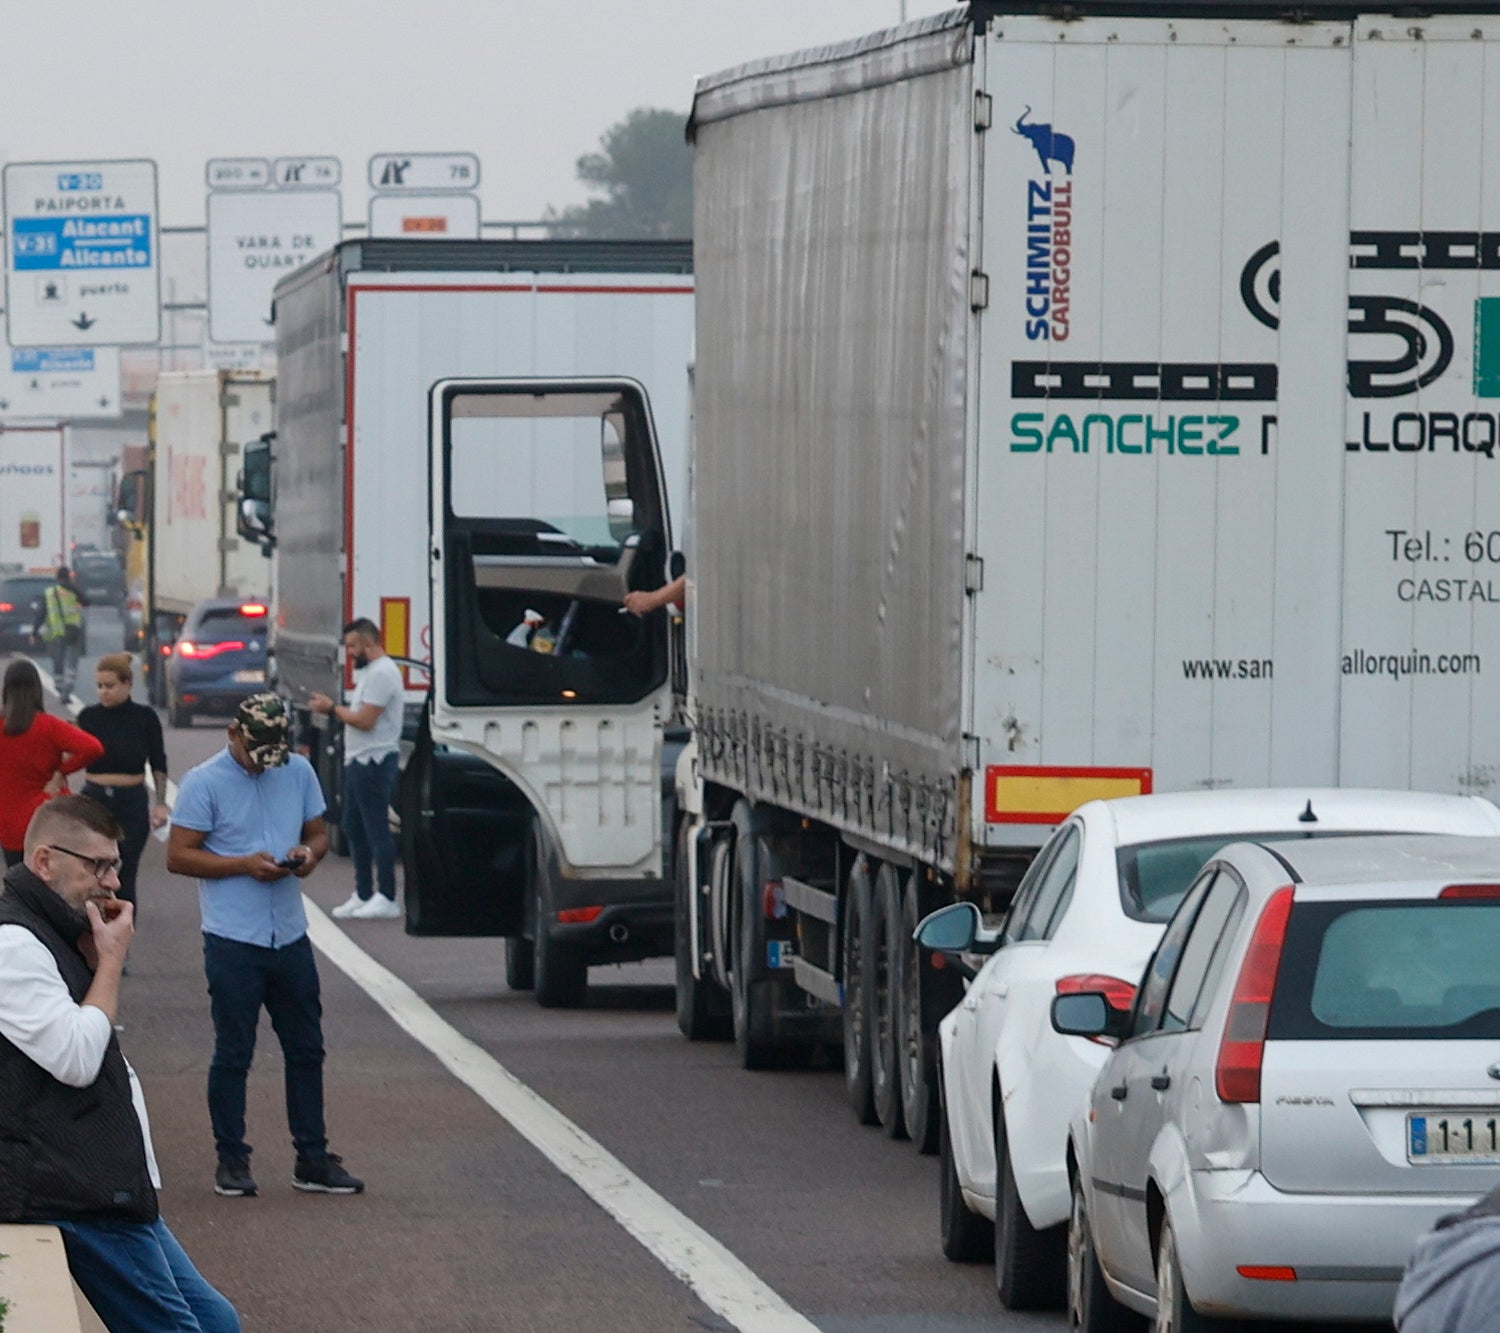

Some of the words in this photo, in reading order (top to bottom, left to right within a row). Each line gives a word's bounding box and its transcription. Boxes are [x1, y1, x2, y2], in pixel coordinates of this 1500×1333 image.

[36, 197, 126, 211] PAIPORTA
[62, 220, 144, 237] Alacant
[236, 235, 281, 249] VARA
[292, 234, 315, 249] DE
[61, 248, 148, 267] Alicante
[1026, 179, 1053, 341] SCHMITZ
[1051, 180, 1072, 342] CARGOBULL
[80, 283, 128, 298] puerto
[1010, 412, 1241, 456] SANCHEZ
[1385, 529, 1450, 563] Tel.:
